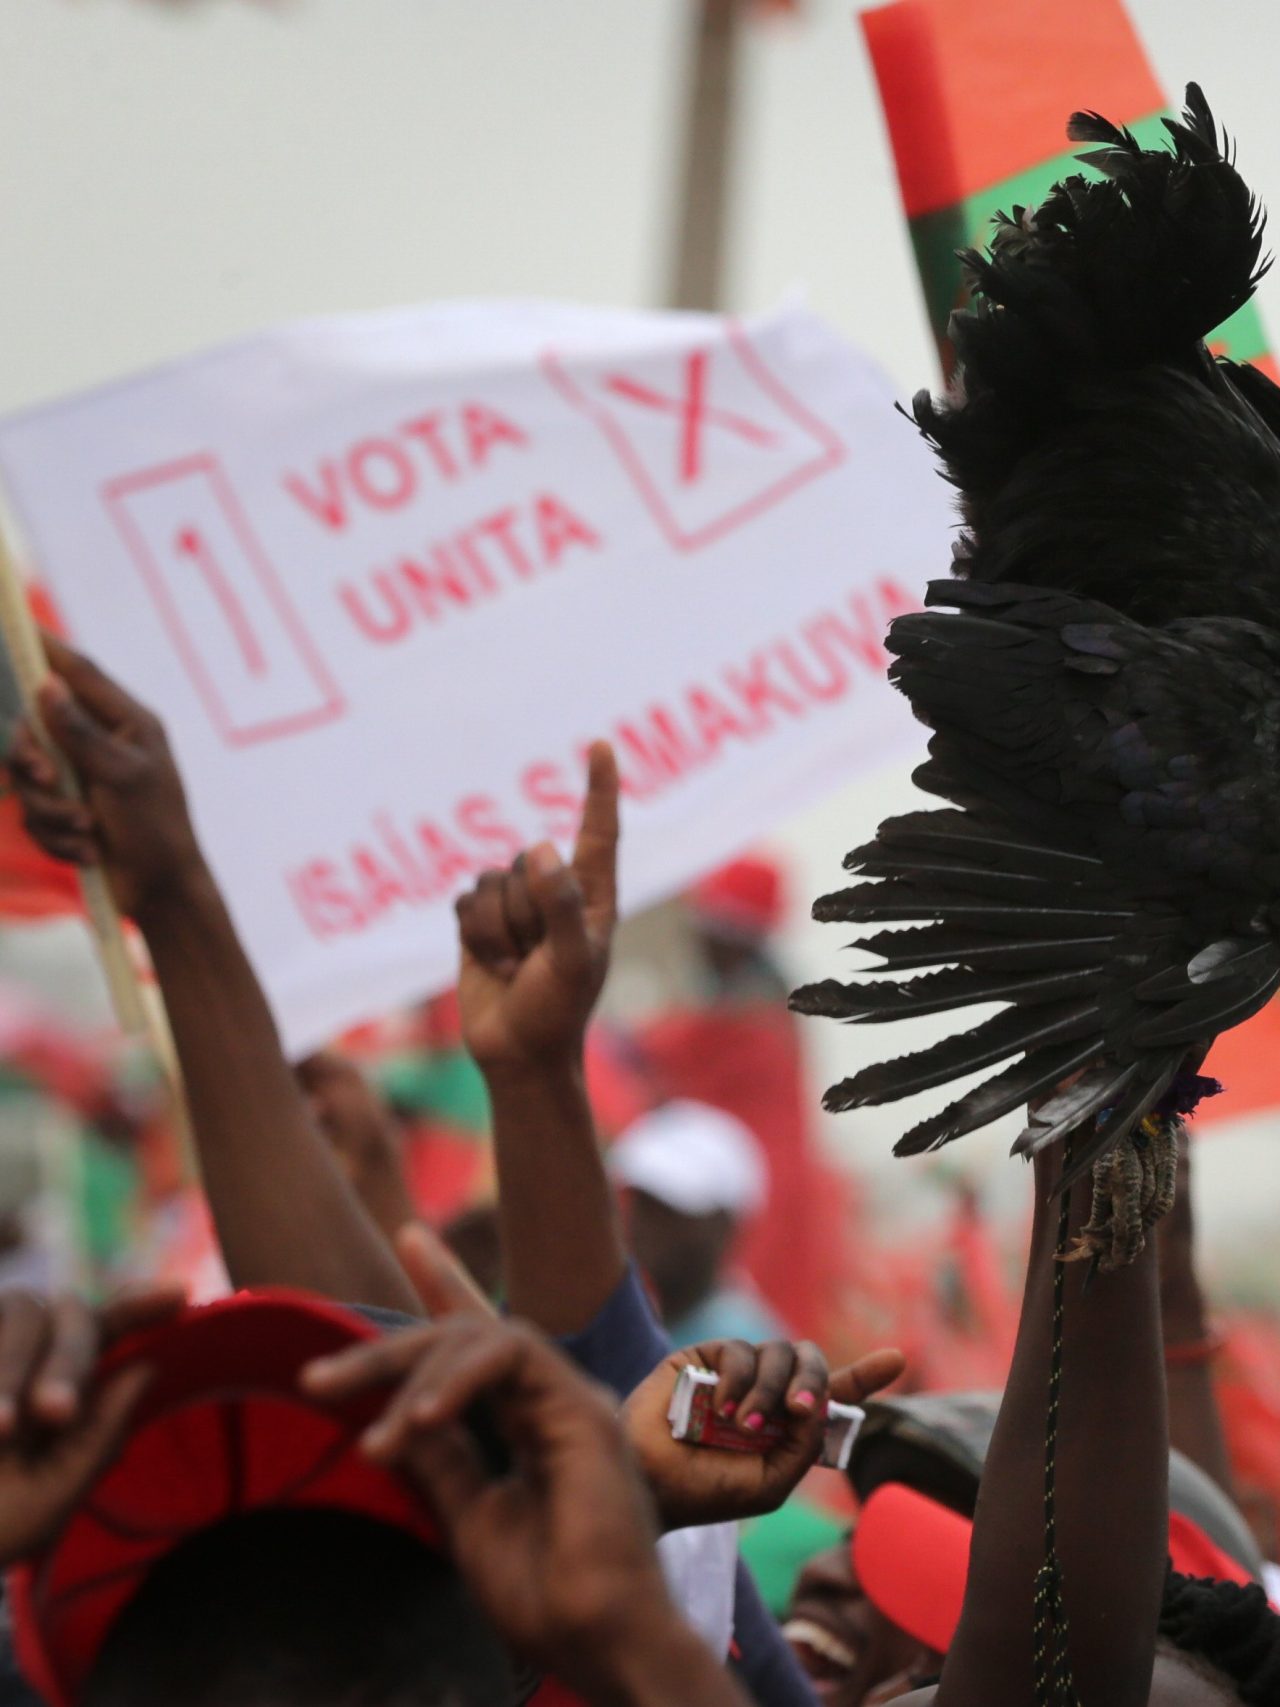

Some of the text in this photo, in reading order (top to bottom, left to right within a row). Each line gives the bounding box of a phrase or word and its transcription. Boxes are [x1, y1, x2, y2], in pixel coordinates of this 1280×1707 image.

[283, 402, 530, 531] VOTA
[174, 524, 268, 679] 1
[336, 492, 604, 645] UNITA
